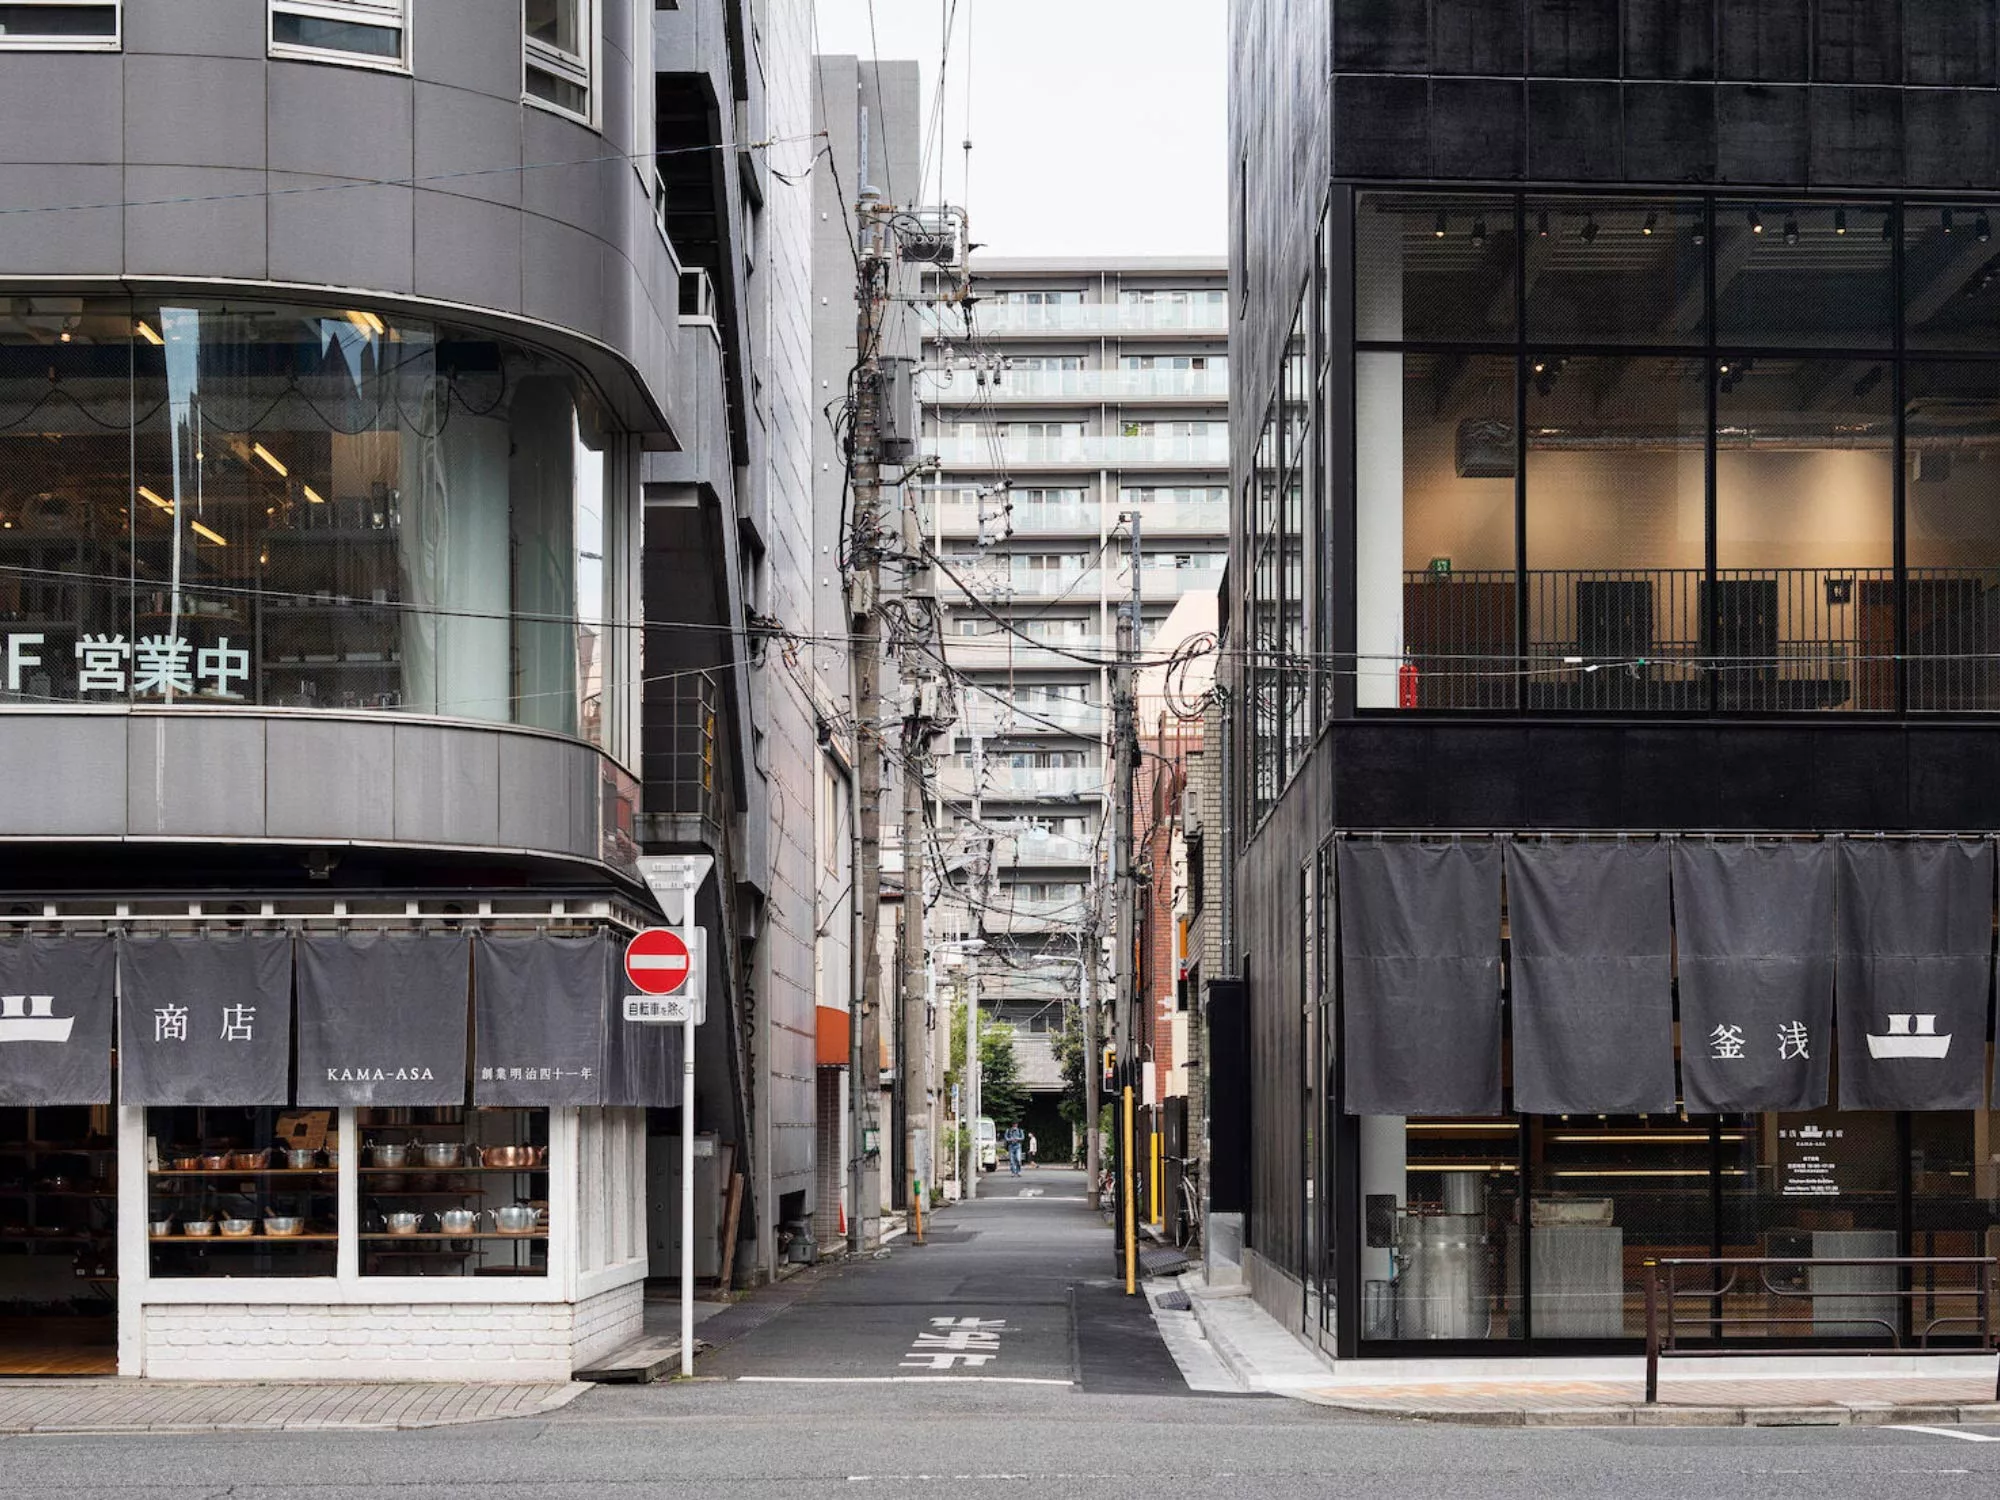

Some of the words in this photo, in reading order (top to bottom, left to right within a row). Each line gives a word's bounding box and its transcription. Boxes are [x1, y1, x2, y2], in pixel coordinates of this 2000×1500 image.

[75, 633, 249, 695] 営業中
[154, 1003, 257, 1042] 商店
[629, 1001, 685, 1016] 自転車を除く
[1709, 1020, 1810, 1060] 釜浅
[327, 1067, 435, 1081] KAMA-ASA
